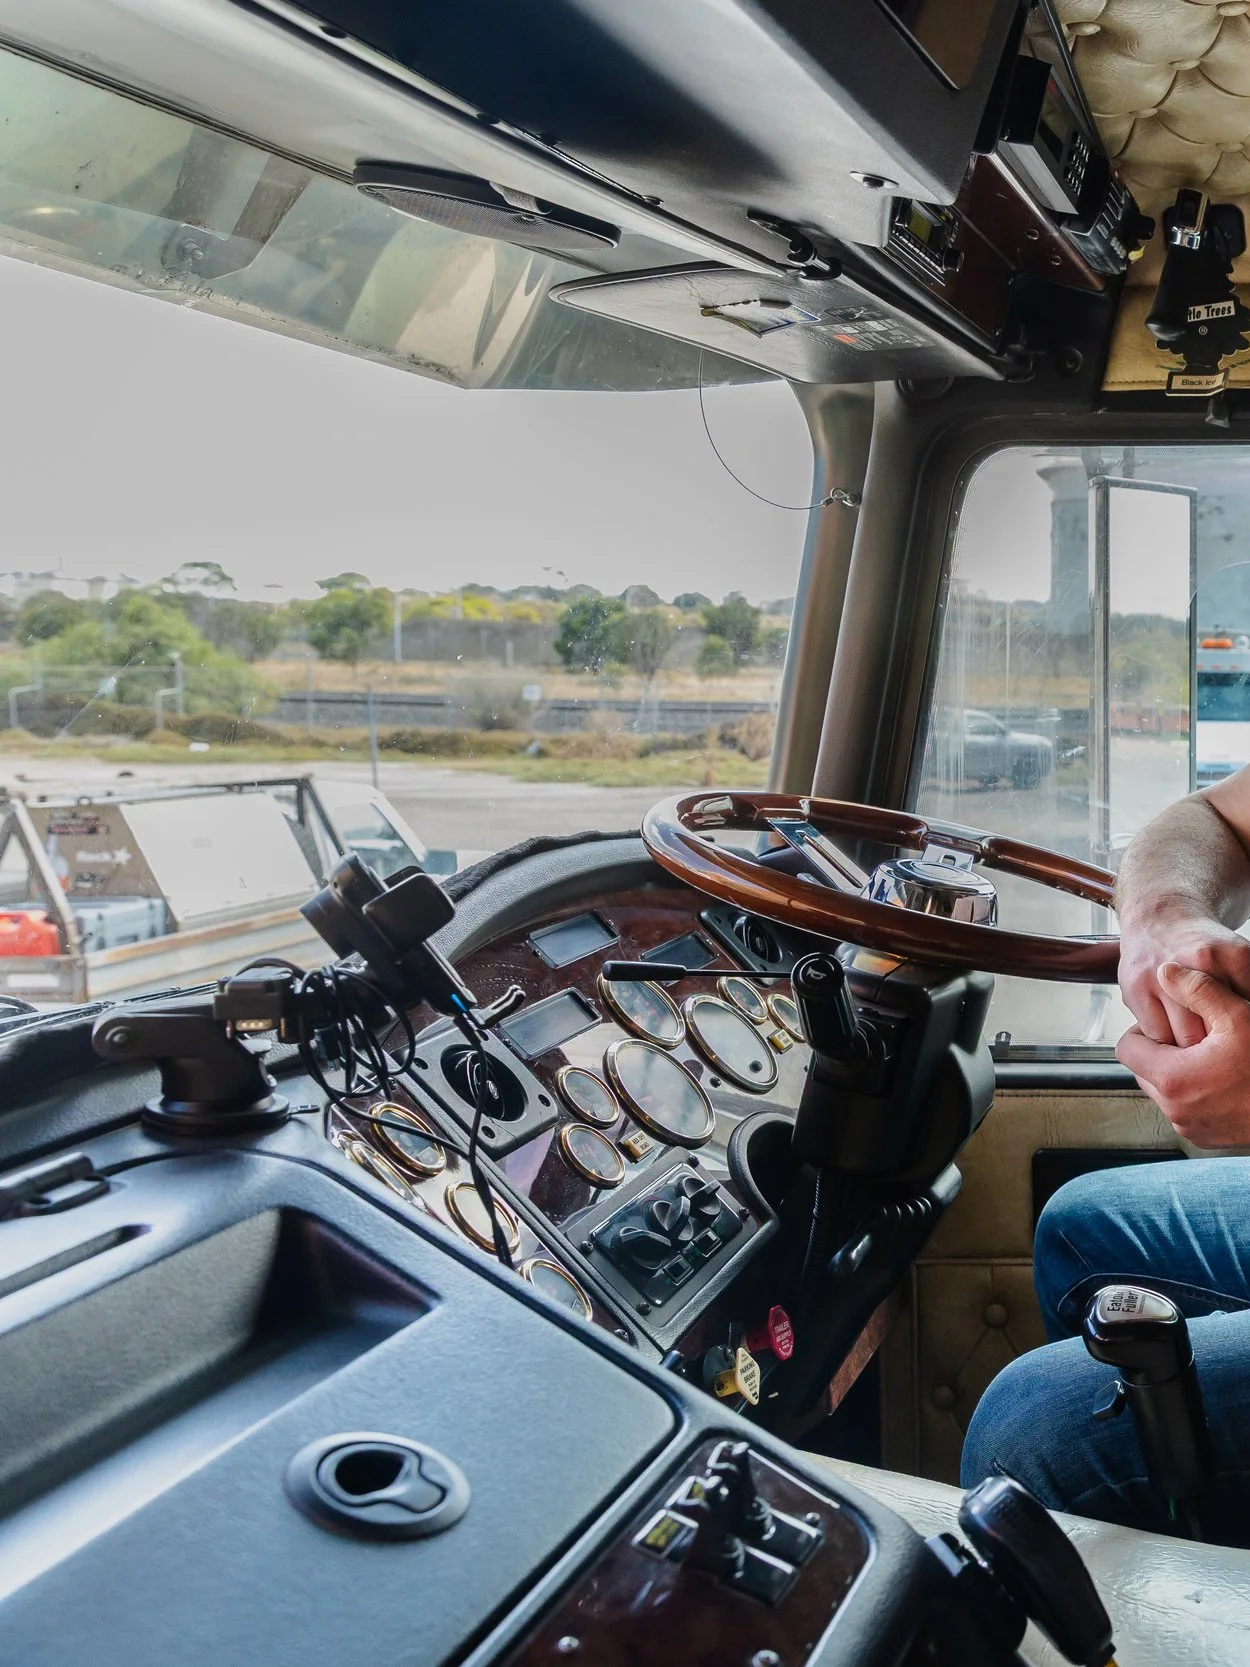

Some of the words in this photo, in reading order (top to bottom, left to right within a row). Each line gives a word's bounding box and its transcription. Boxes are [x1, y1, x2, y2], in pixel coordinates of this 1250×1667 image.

[1204, 305, 1232, 317] Trees
[1107, 1291, 1124, 1311] Eaton
[1122, 1293, 1138, 1312] Fuller
[774, 1321, 790, 1334] TRAILER
[740, 1361, 755, 1375] PARKING
[744, 1370, 756, 1383] BRAKE
